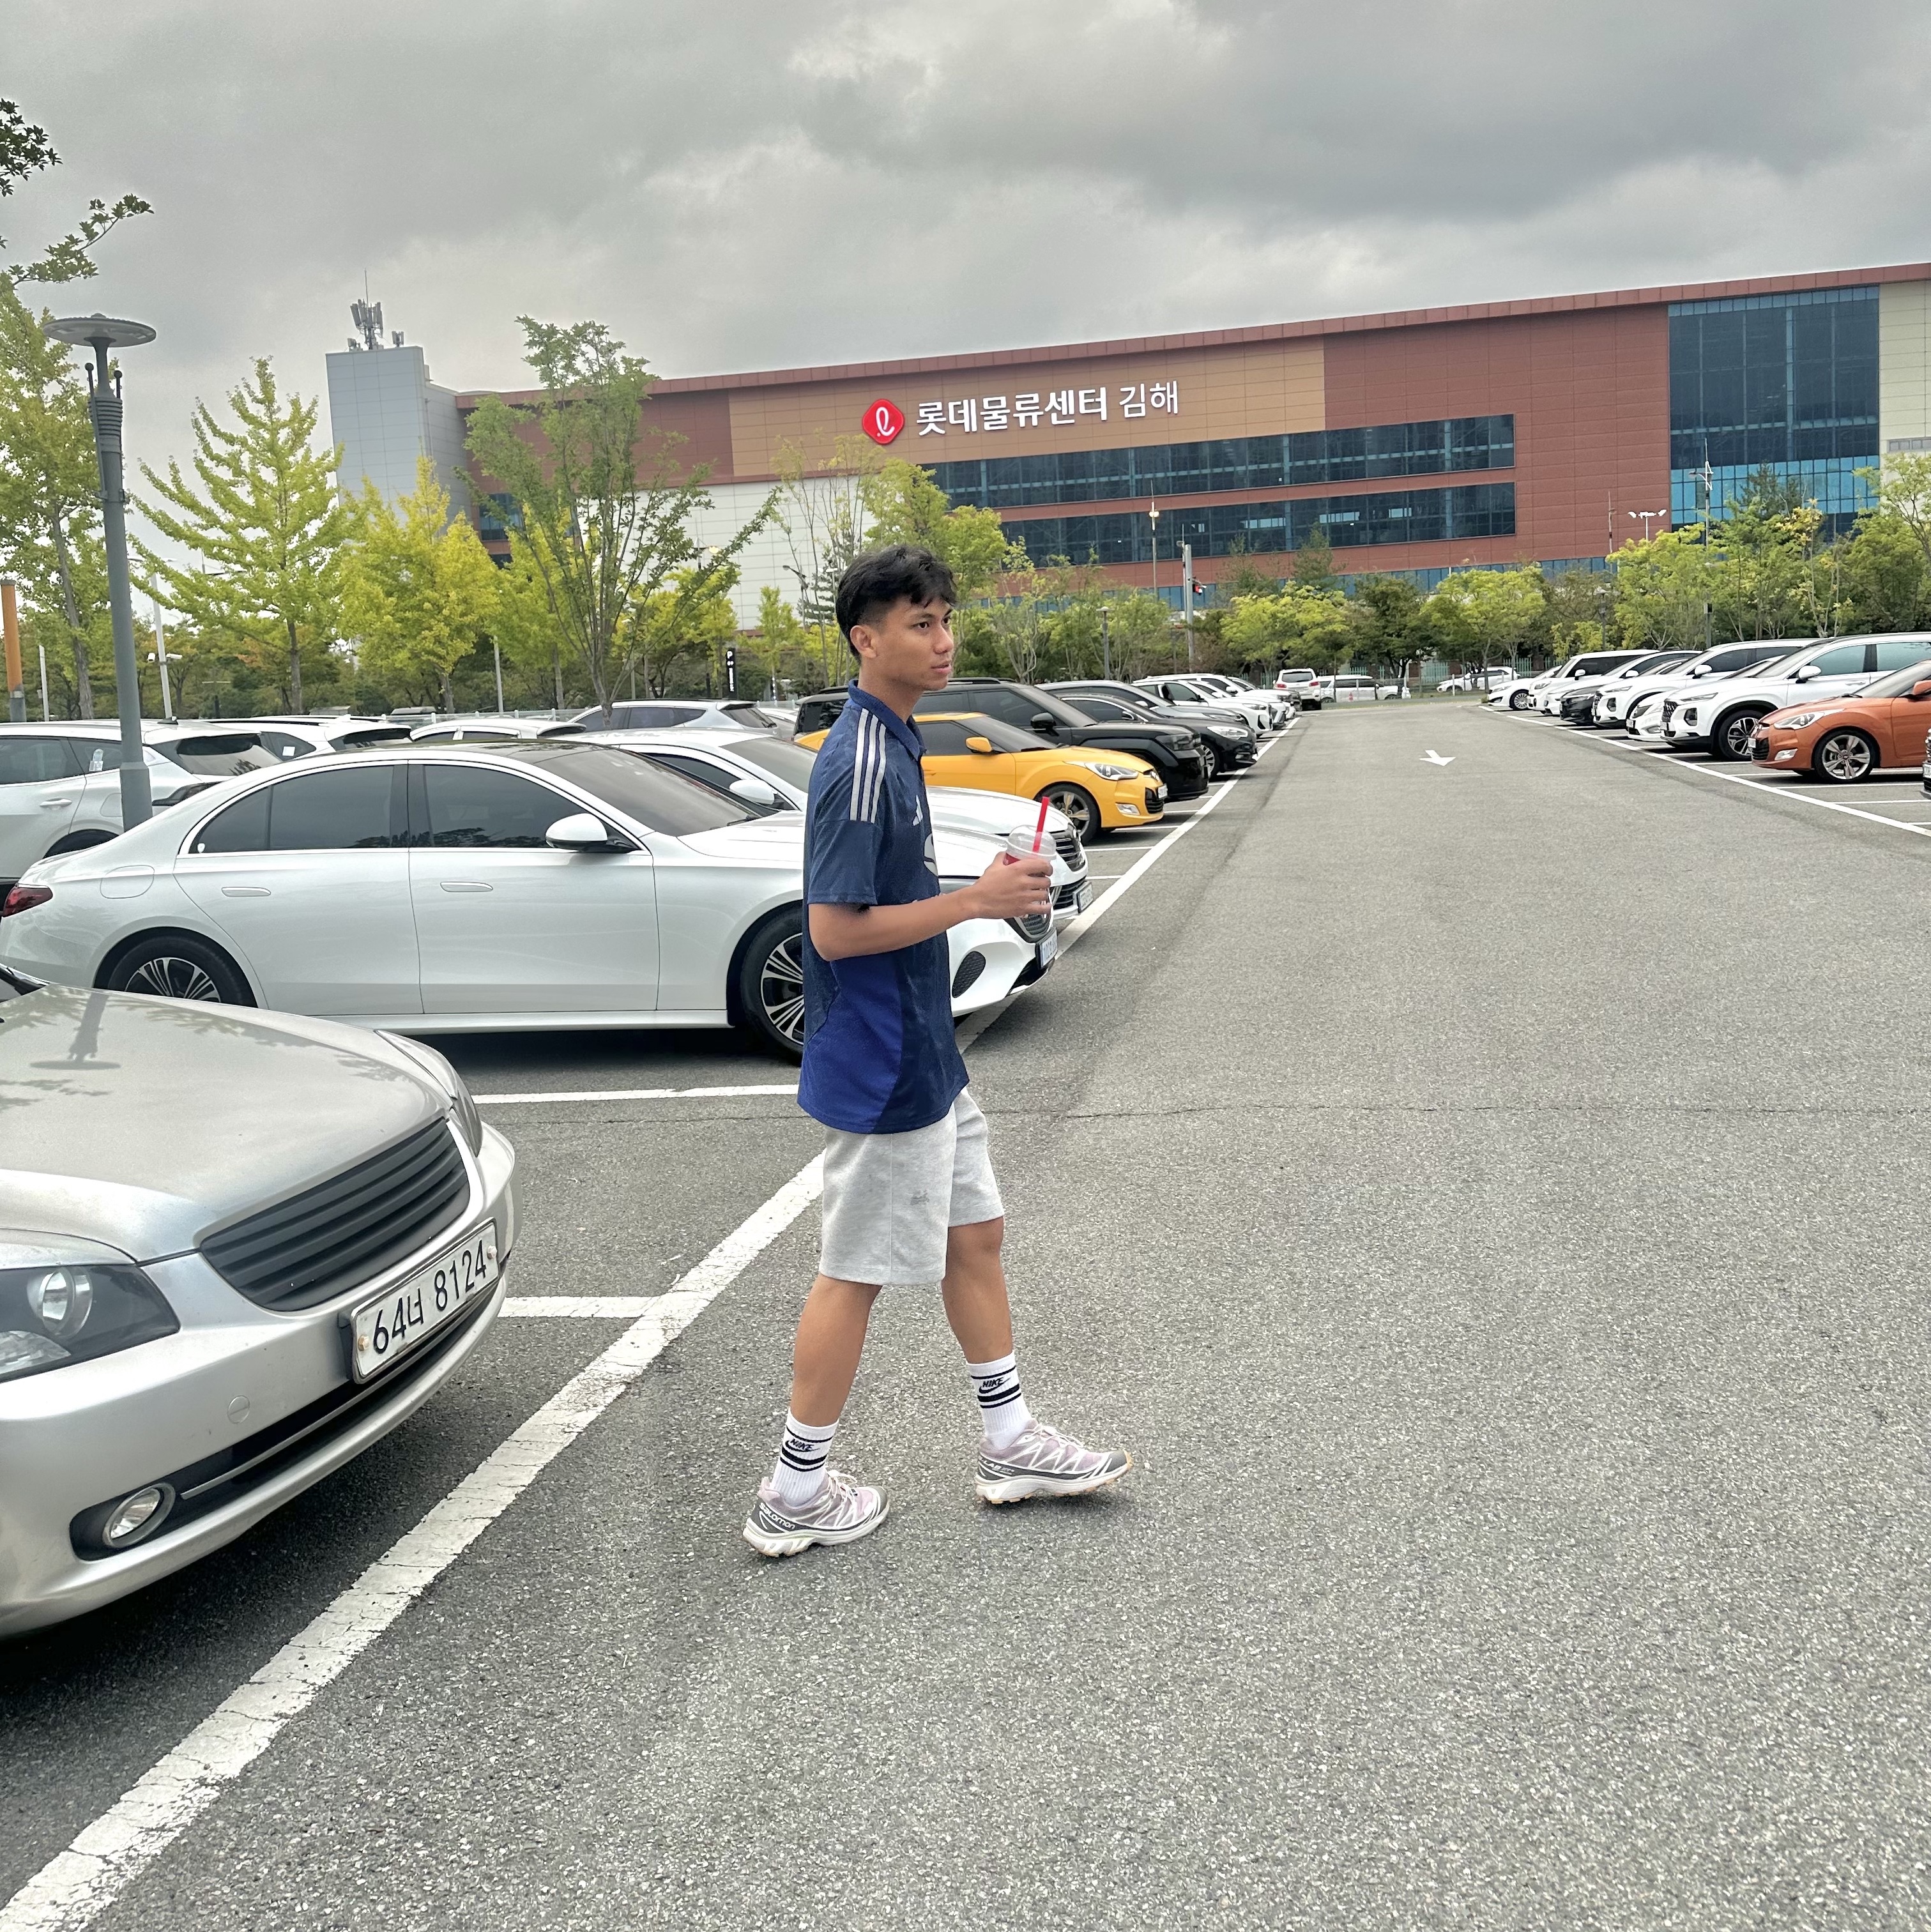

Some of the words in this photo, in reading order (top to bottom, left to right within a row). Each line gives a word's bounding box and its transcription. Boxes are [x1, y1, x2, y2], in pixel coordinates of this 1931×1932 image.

[916, 386, 1108, 436] 롯데물류센터
[1118, 380, 1179, 418] 김해
[373, 1288, 424, 1354] 64너
[434, 1239, 486, 1311] 8124
[982, 1377, 1004, 1387] NIKE
[790, 1438, 814, 1450] NIKE
